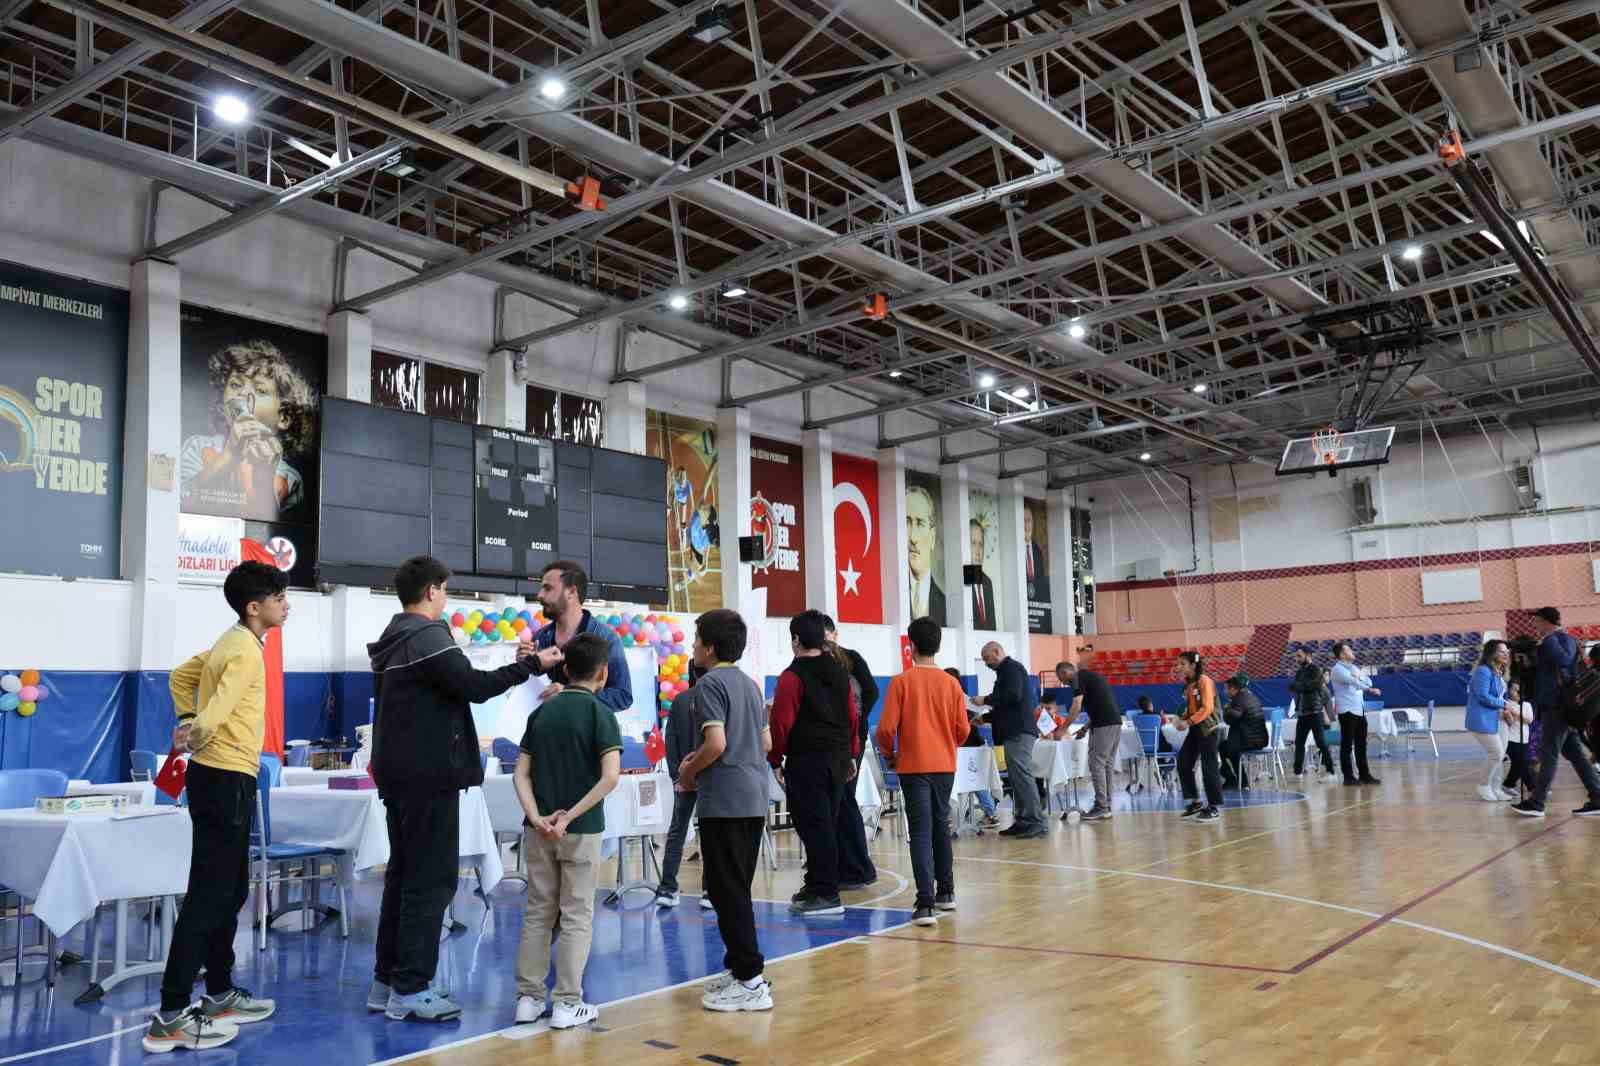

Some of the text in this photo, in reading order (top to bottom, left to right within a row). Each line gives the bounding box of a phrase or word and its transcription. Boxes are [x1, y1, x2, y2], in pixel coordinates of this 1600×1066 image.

[42, 294, 103, 321] MERKEZLERİ
[35, 376, 103, 419] SPOR
[33, 415, 81, 455] HER
[32, 454, 108, 496] YERDE
[507, 507, 529, 519] Period
[484, 536, 507, 547] SCORE
[531, 541, 552, 552] SCORE
